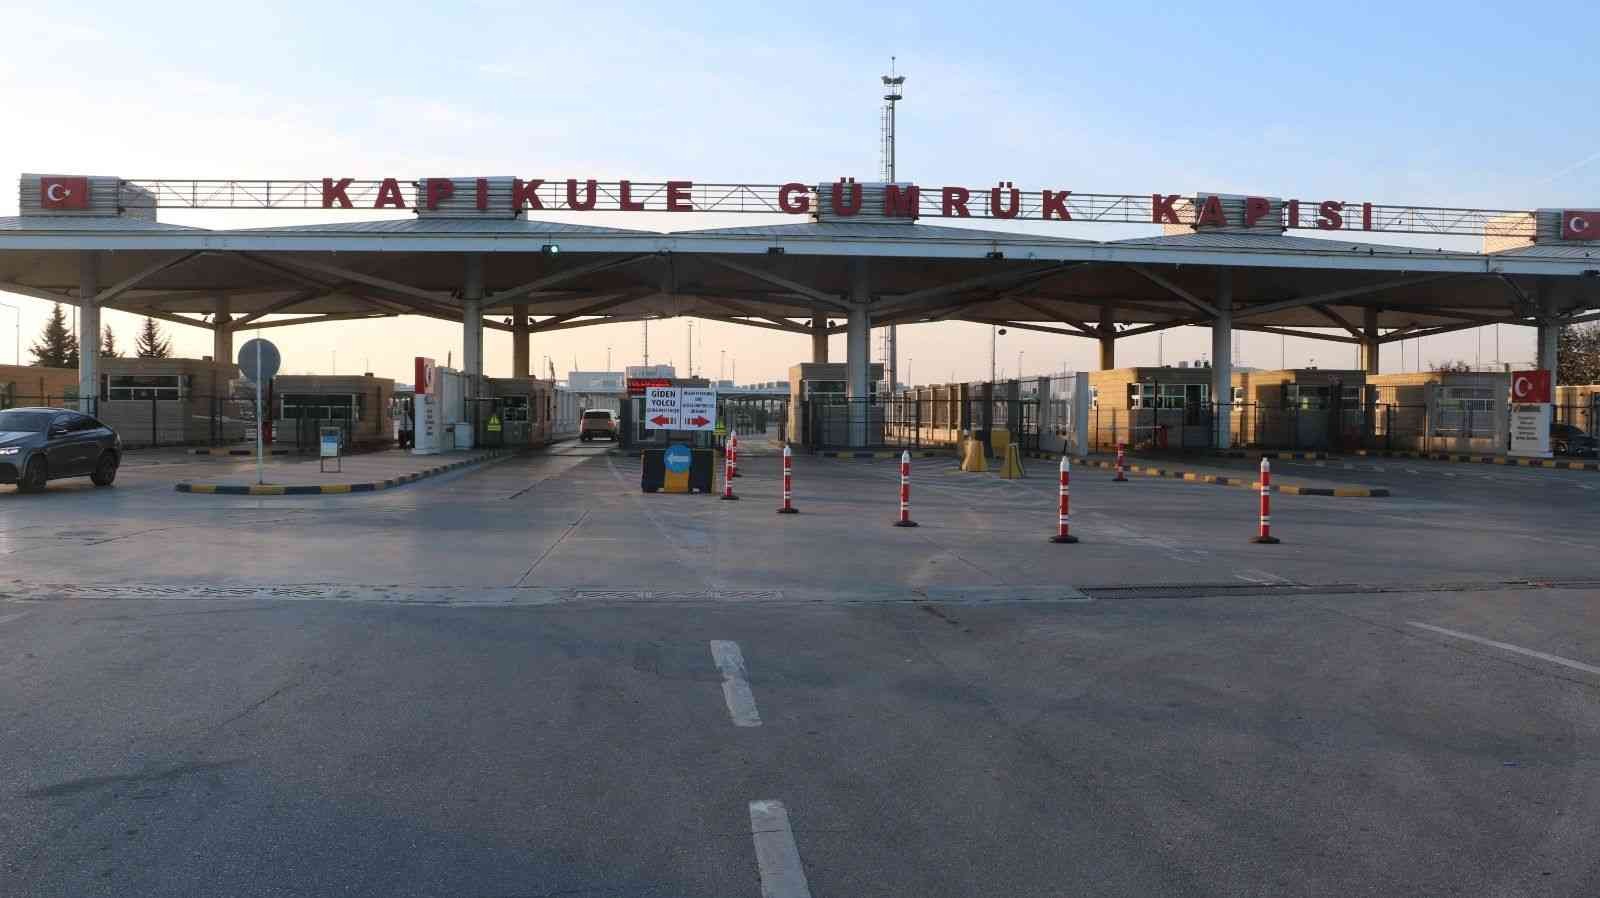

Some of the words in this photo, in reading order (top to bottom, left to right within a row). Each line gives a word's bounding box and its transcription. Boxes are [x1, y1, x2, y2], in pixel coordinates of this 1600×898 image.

[322, 178, 692, 211] KAPIKULE
[779, 177, 1072, 221] GÜMRÜK
[1152, 194, 1372, 231] KAPISI
[651, 389, 676, 398] GİDEN
[651, 399, 676, 407] YOLCU
